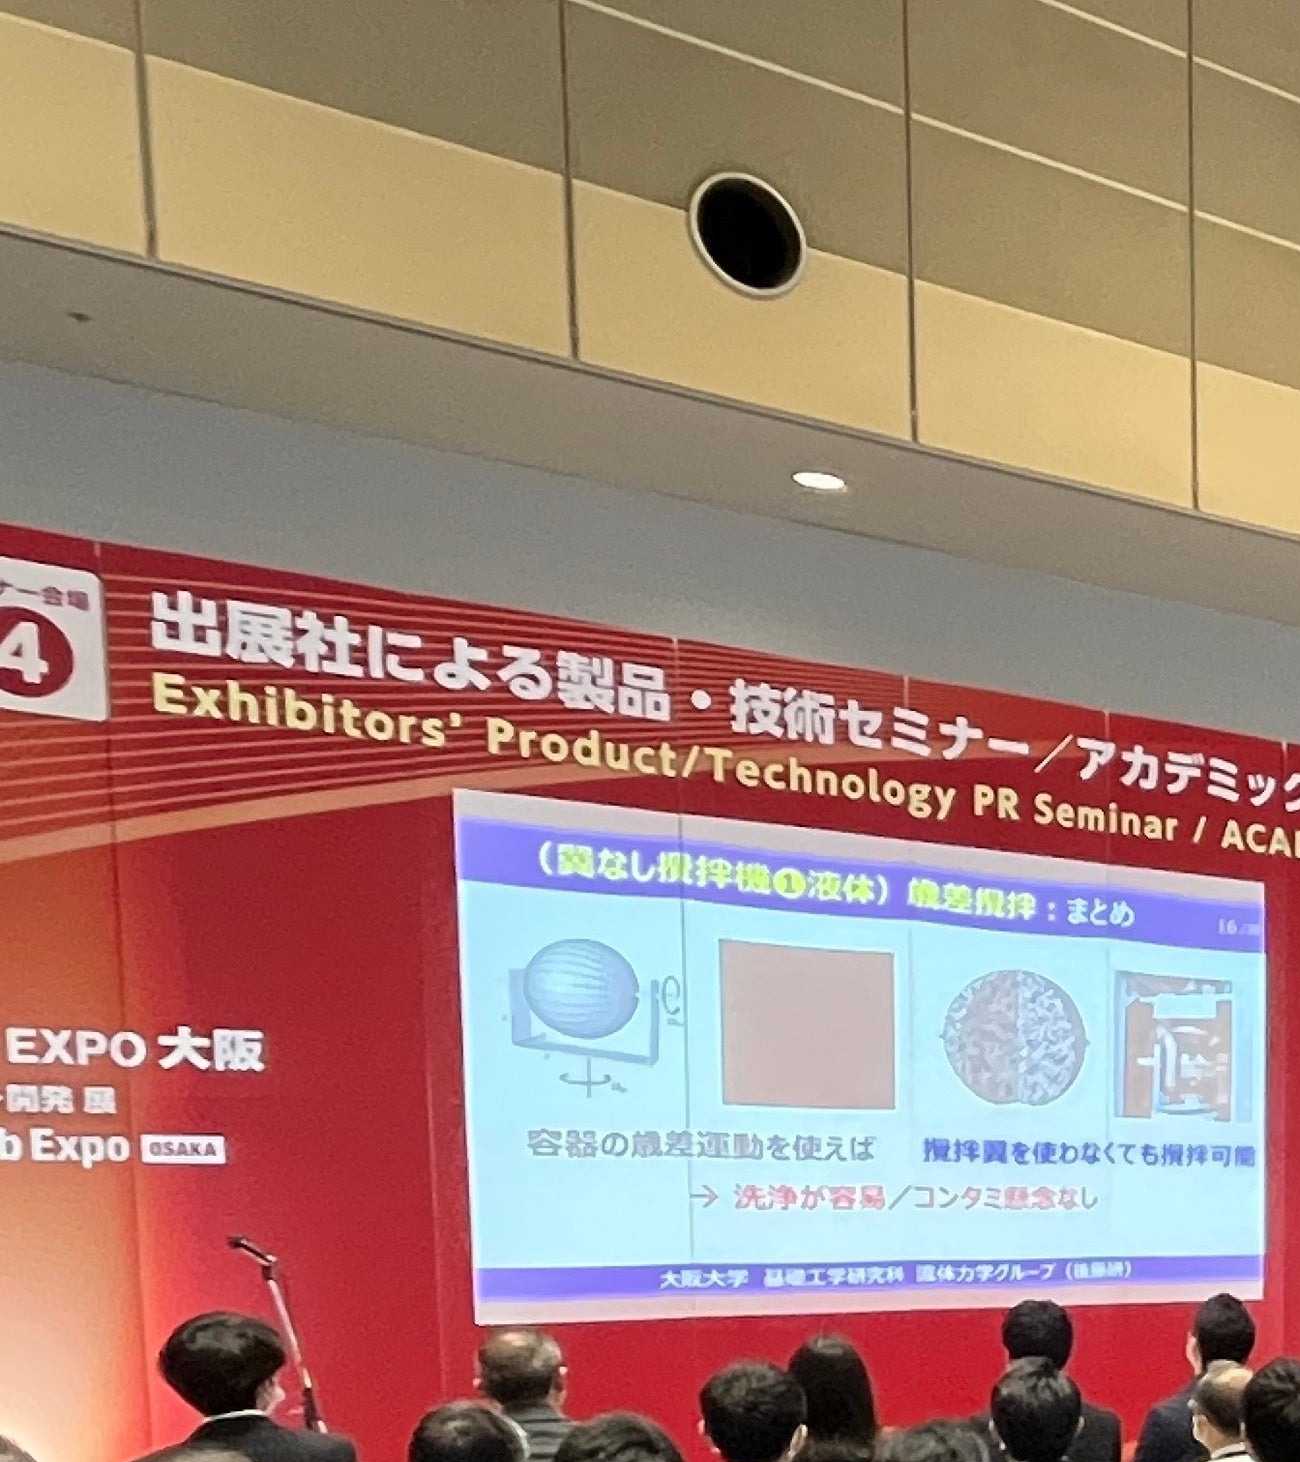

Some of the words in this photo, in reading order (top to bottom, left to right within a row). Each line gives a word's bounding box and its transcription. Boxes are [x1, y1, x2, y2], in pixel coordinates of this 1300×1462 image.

[487, 717, 957, 821] Product/Technology
[973, 784, 1021, 821] PR
[1034, 793, 1179, 843] Seminar
[6, 1027, 148, 1068] EXPO
[157, 1026, 265, 1072] 大阪
[30, 1128, 130, 1169] Expo
[149, 1141, 217, 1158] OSAKA
[660, 1269, 749, 1291] 大阪大学
